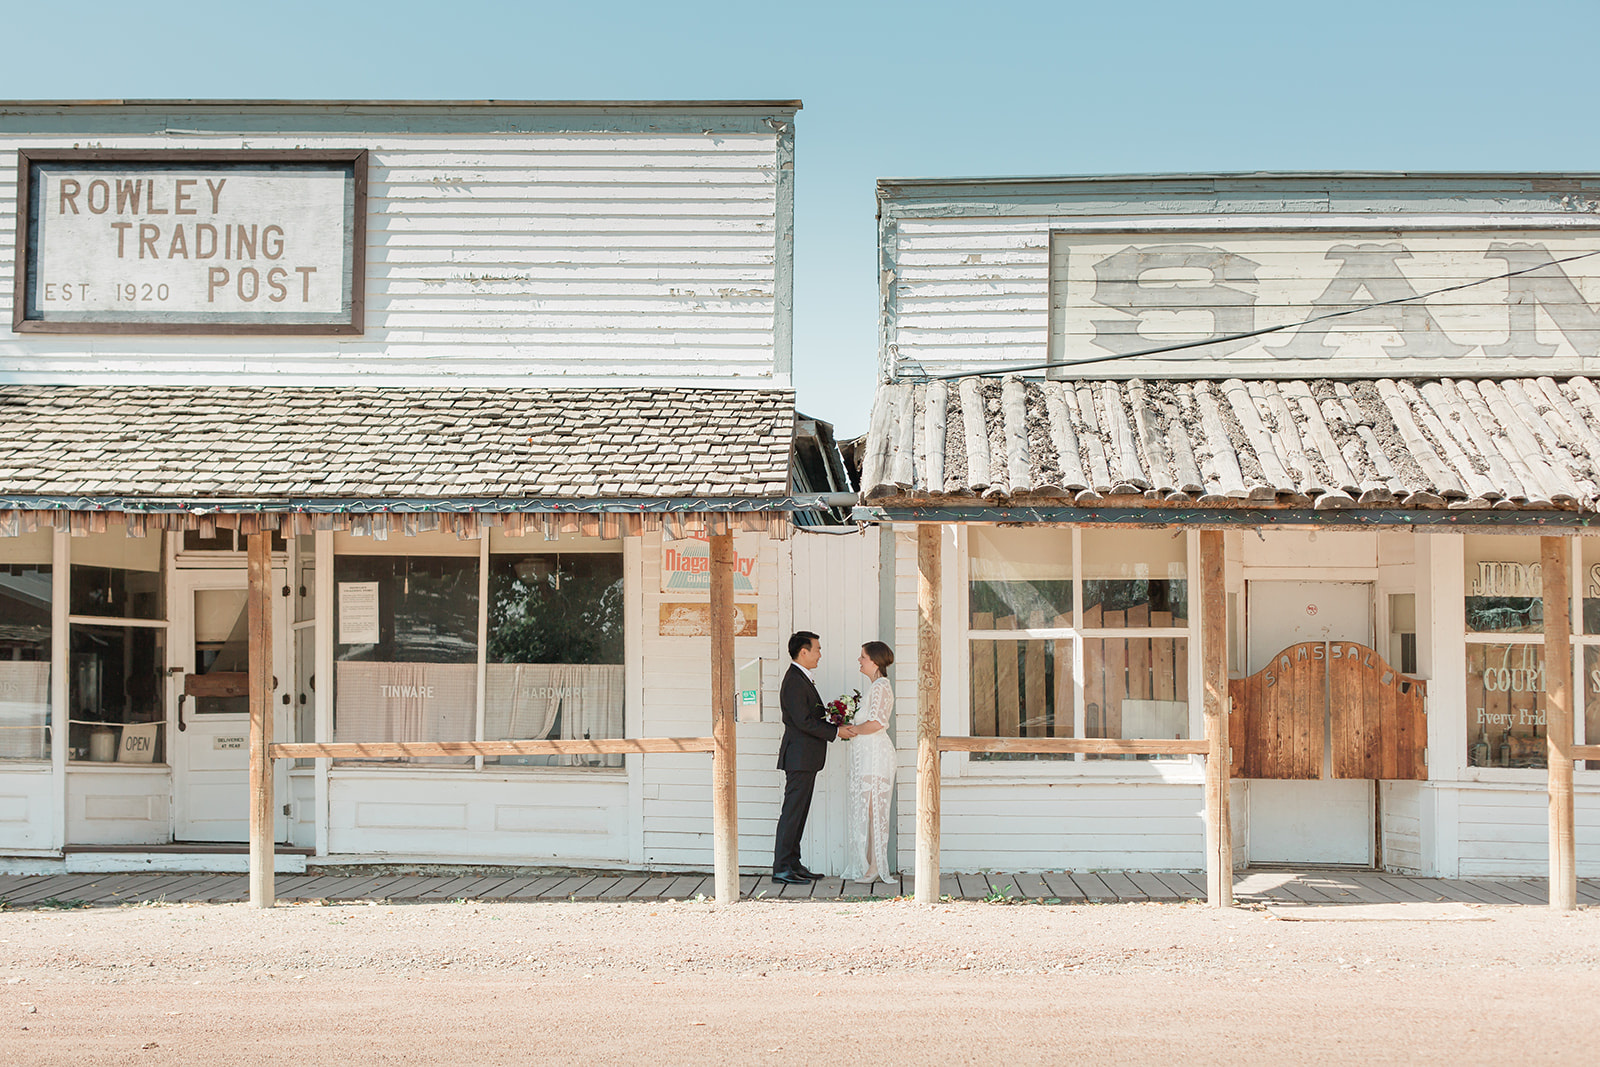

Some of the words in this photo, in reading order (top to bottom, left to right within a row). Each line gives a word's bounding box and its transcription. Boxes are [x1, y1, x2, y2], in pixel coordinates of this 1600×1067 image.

[59, 178, 227, 215] ROWLEY
[110, 222, 285, 260] TRADING
[116, 283, 170, 301] 1920
[207, 266, 318, 303] POST
[665, 549, 710, 574] Niaga
[380, 685, 434, 699] TINWARE
[522, 687, 588, 699] HARDWARE
[1476, 707, 1517, 730] Every
[125, 736, 151, 752] OPEN
